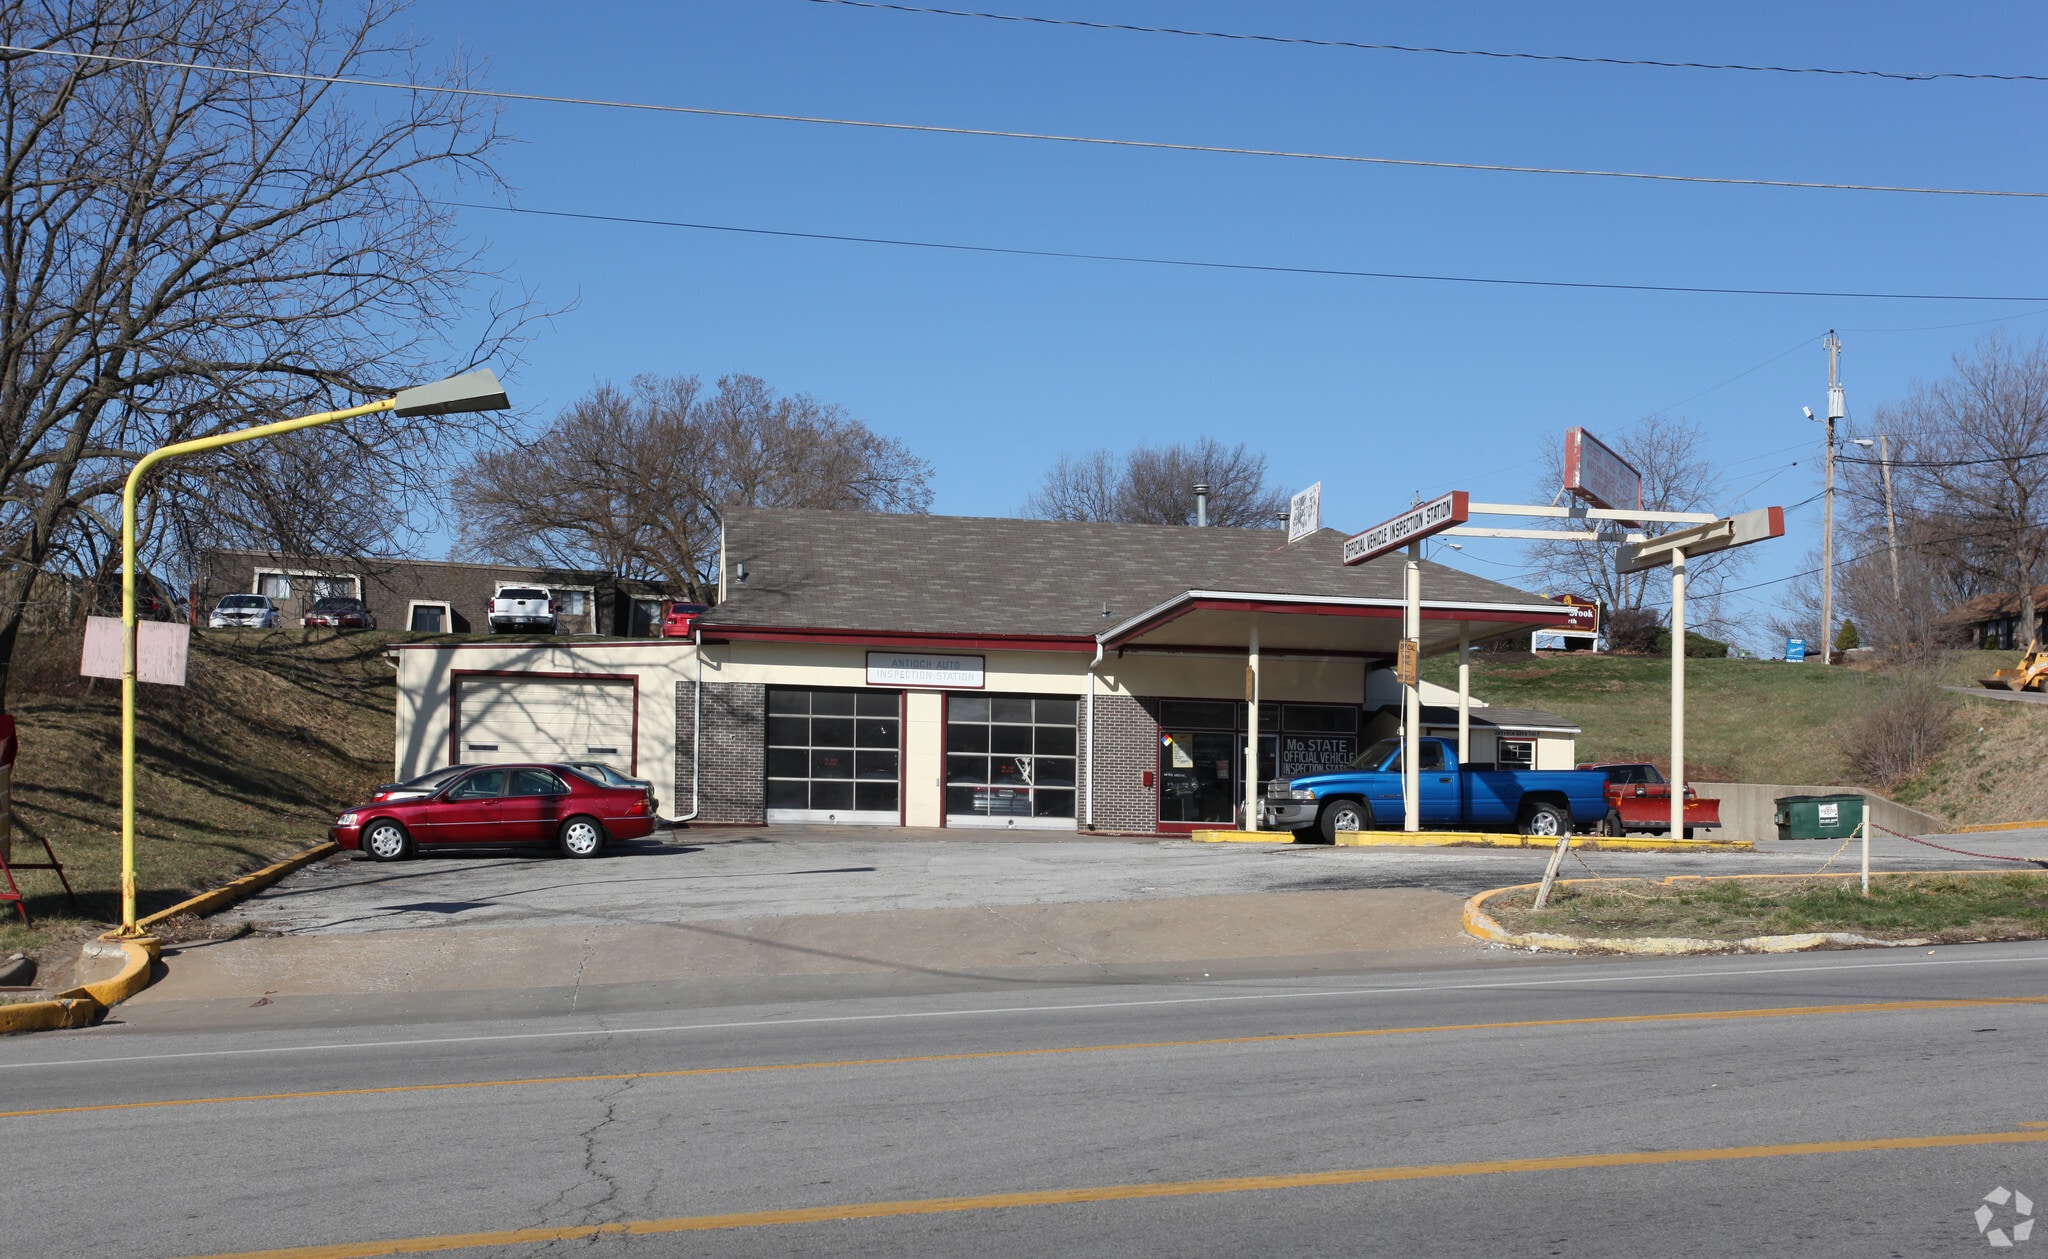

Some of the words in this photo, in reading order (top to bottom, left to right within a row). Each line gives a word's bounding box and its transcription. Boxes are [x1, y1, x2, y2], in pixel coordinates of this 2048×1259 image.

[1345, 537, 1366, 559] OFFICIAL
[1366, 527, 1387, 549] VEHICLE
[1389, 511, 1424, 539] INSPECTION
[1426, 498, 1451, 525] STATION
[892, 659, 932, 669] ANTIOCH
[936, 660, 960, 670] AUTO
[877, 670, 932, 680] INSPECTION
[937, 672, 975, 681] STATION
[1287, 739, 1305, 751] Mo.
[1308, 740, 1347, 752] STATE
[1284, 751, 1319, 763] OFFICIAL
[1320, 753, 1354, 764] VEHICLE
